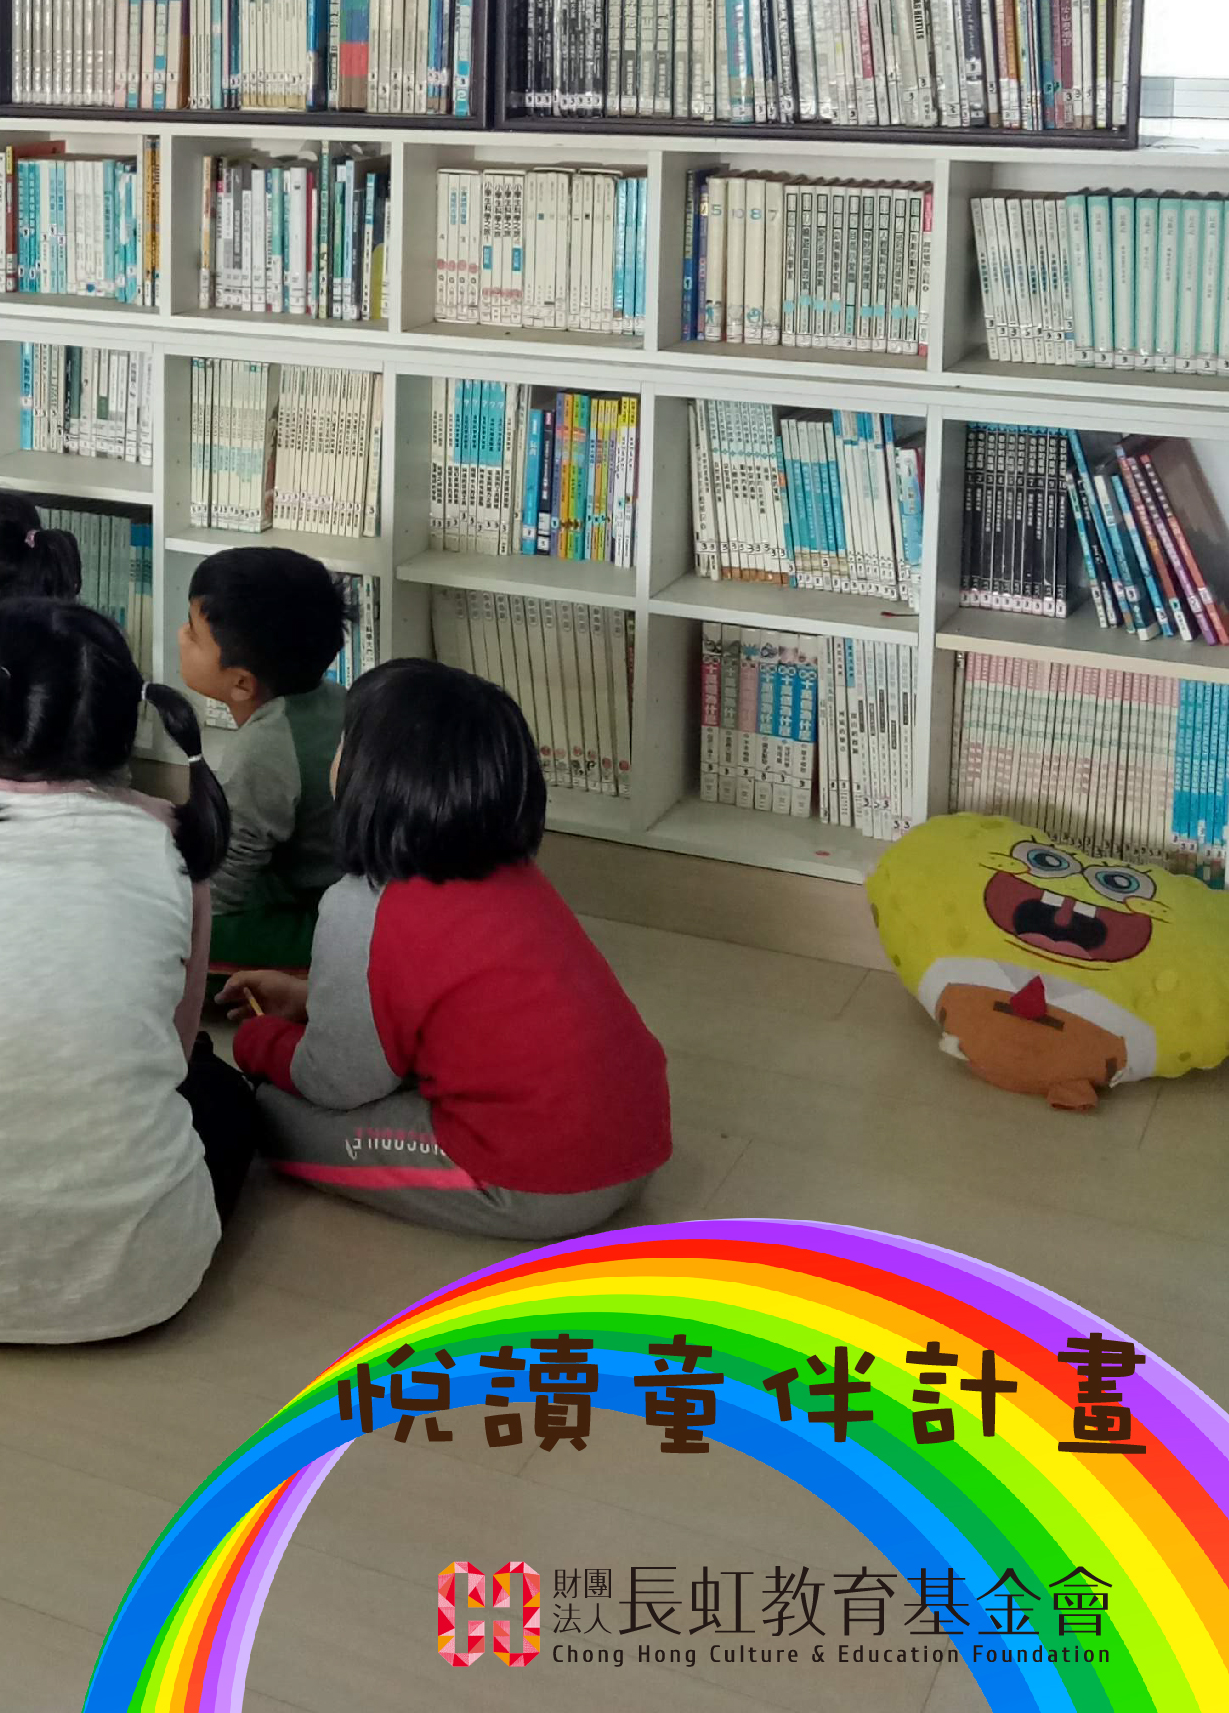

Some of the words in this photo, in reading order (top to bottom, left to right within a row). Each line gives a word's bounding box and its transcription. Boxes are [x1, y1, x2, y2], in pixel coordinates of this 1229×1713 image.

[710, 204, 722, 216] 5
[749, 207, 762, 220] 8
[767, 209, 779, 221] 7
[352, 1128, 447, 1158] ROCODILE
